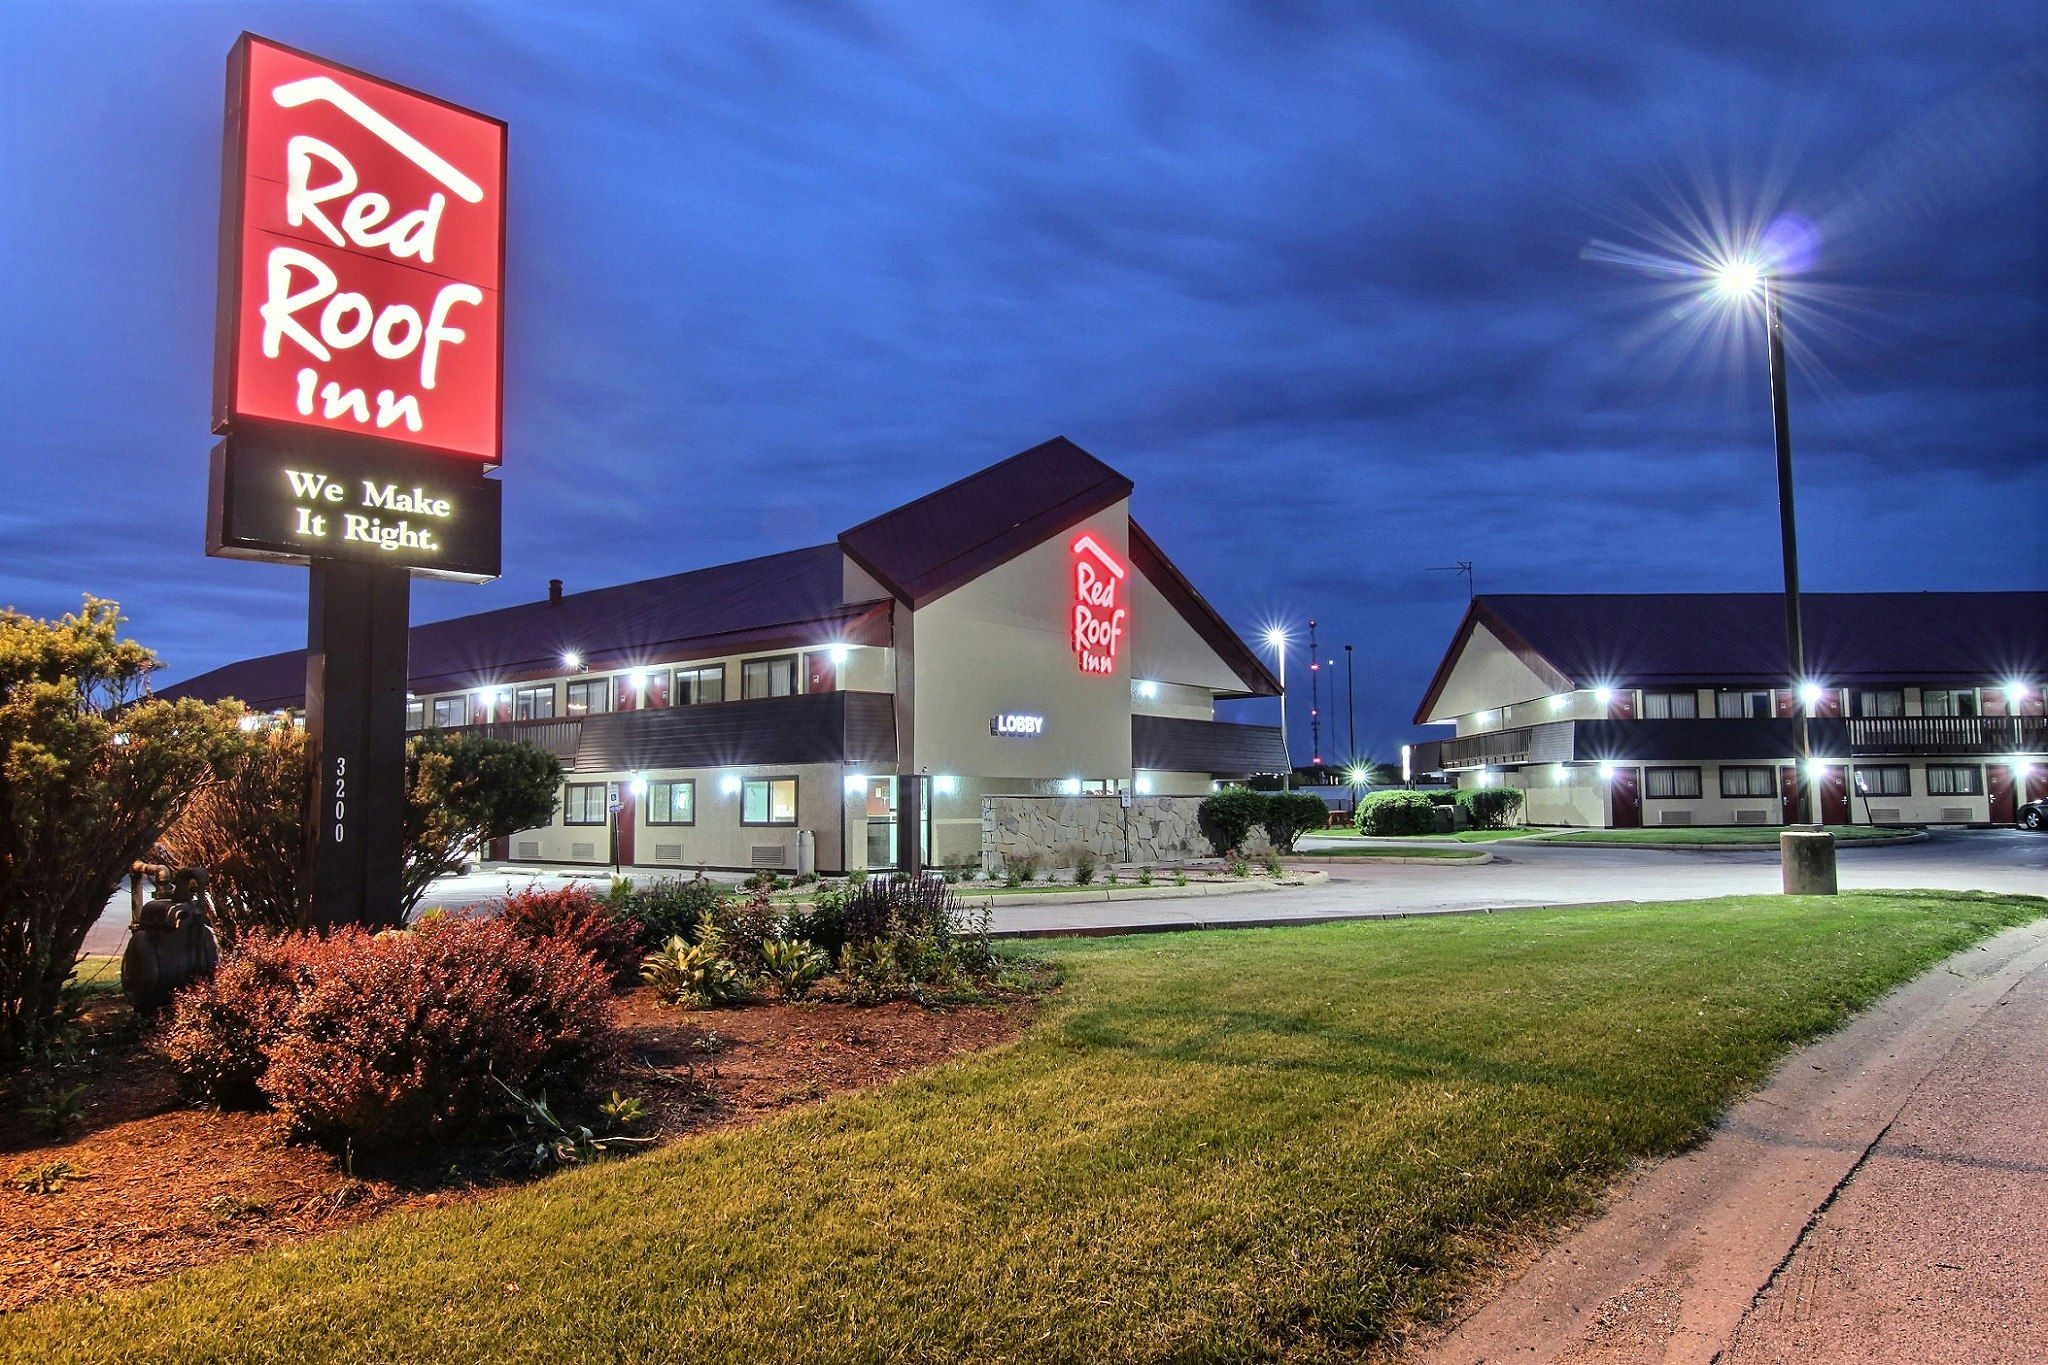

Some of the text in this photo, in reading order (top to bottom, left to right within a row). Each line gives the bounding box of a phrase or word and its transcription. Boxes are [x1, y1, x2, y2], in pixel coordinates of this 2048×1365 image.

[286, 135, 446, 263] Red
[260, 246, 483, 390] Roof
[285, 469, 451, 517] We Make
[296, 507, 439, 550] It Right.
[1078, 561, 1115, 608] Red
[1075, 605, 1125, 656] Roof
[1082, 650, 1113, 673] Inn
[998, 714, 1043, 733] LOBBY
[334, 757, 346, 843] 3200
